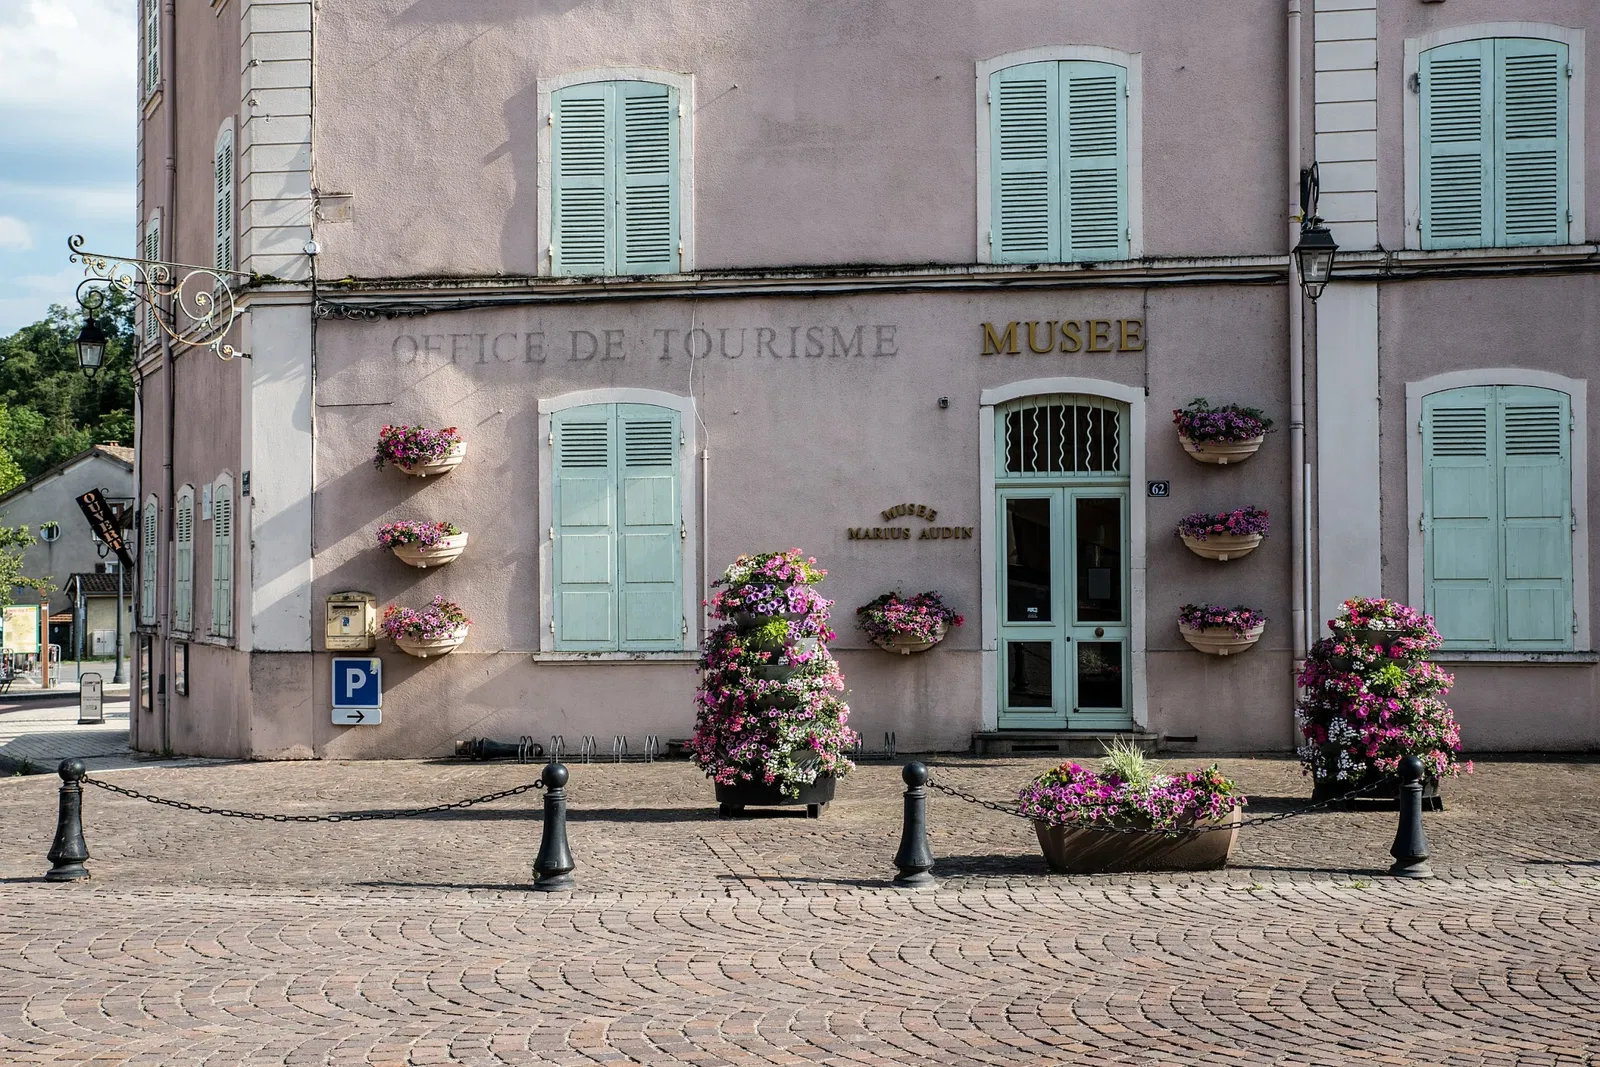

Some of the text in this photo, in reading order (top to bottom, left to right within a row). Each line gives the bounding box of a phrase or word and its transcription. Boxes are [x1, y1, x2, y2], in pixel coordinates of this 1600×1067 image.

[391, 325, 899, 365] OFFICE DE TOURISME
[980, 319, 1145, 355] MUSEE
[1152, 483, 1165, 495] 62
[83, 493, 122, 550] OUVERT
[881, 503, 938, 522] MUSEE
[847, 526, 974, 540] MARIUS AUDIN
[346, 668, 367, 698] P
